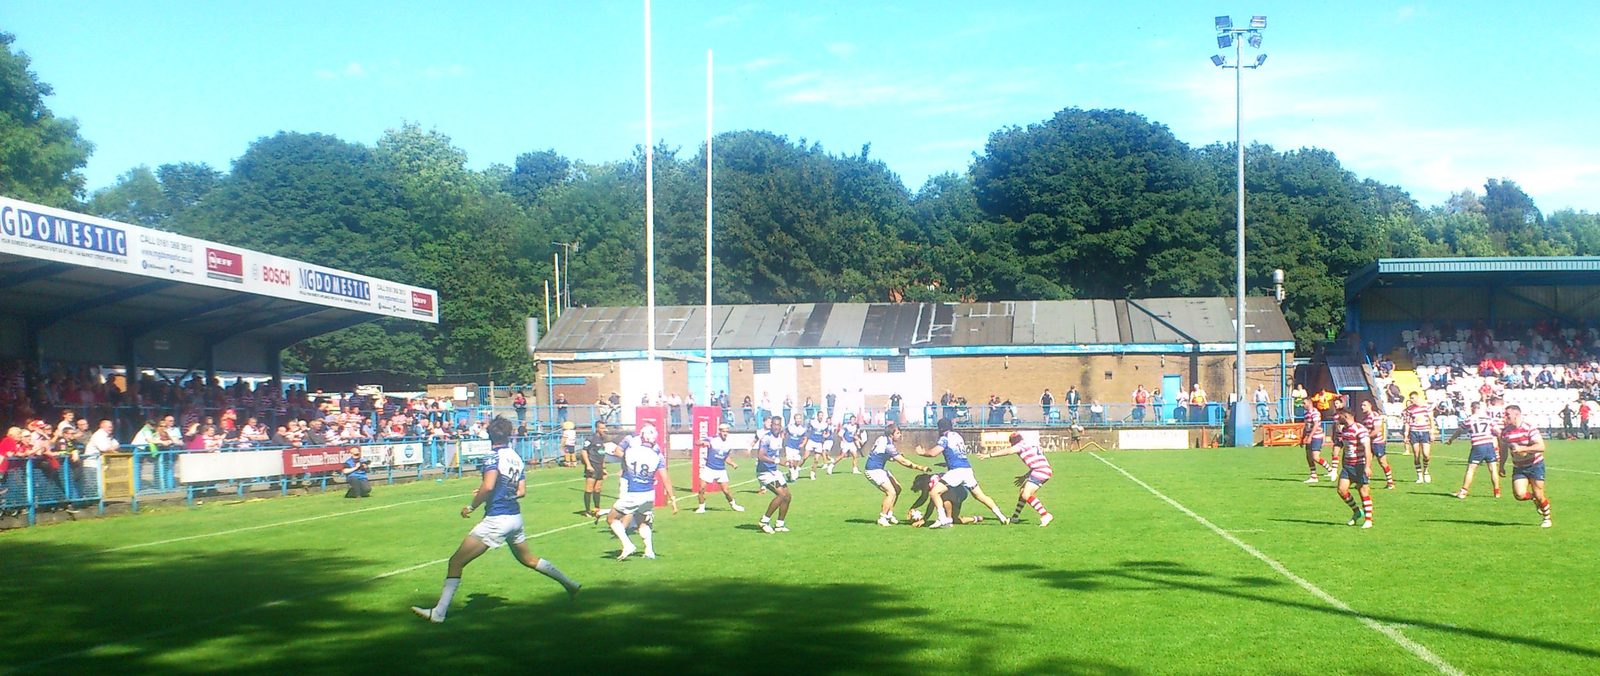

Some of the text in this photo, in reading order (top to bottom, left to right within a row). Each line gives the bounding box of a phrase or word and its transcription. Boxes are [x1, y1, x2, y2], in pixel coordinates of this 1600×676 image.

[0, 205, 127, 256] GDOMESTIC
[262, 265, 292, 286] BOSCH
[1473, 422, 1488, 434] 17
[631, 461, 650, 477] 18
